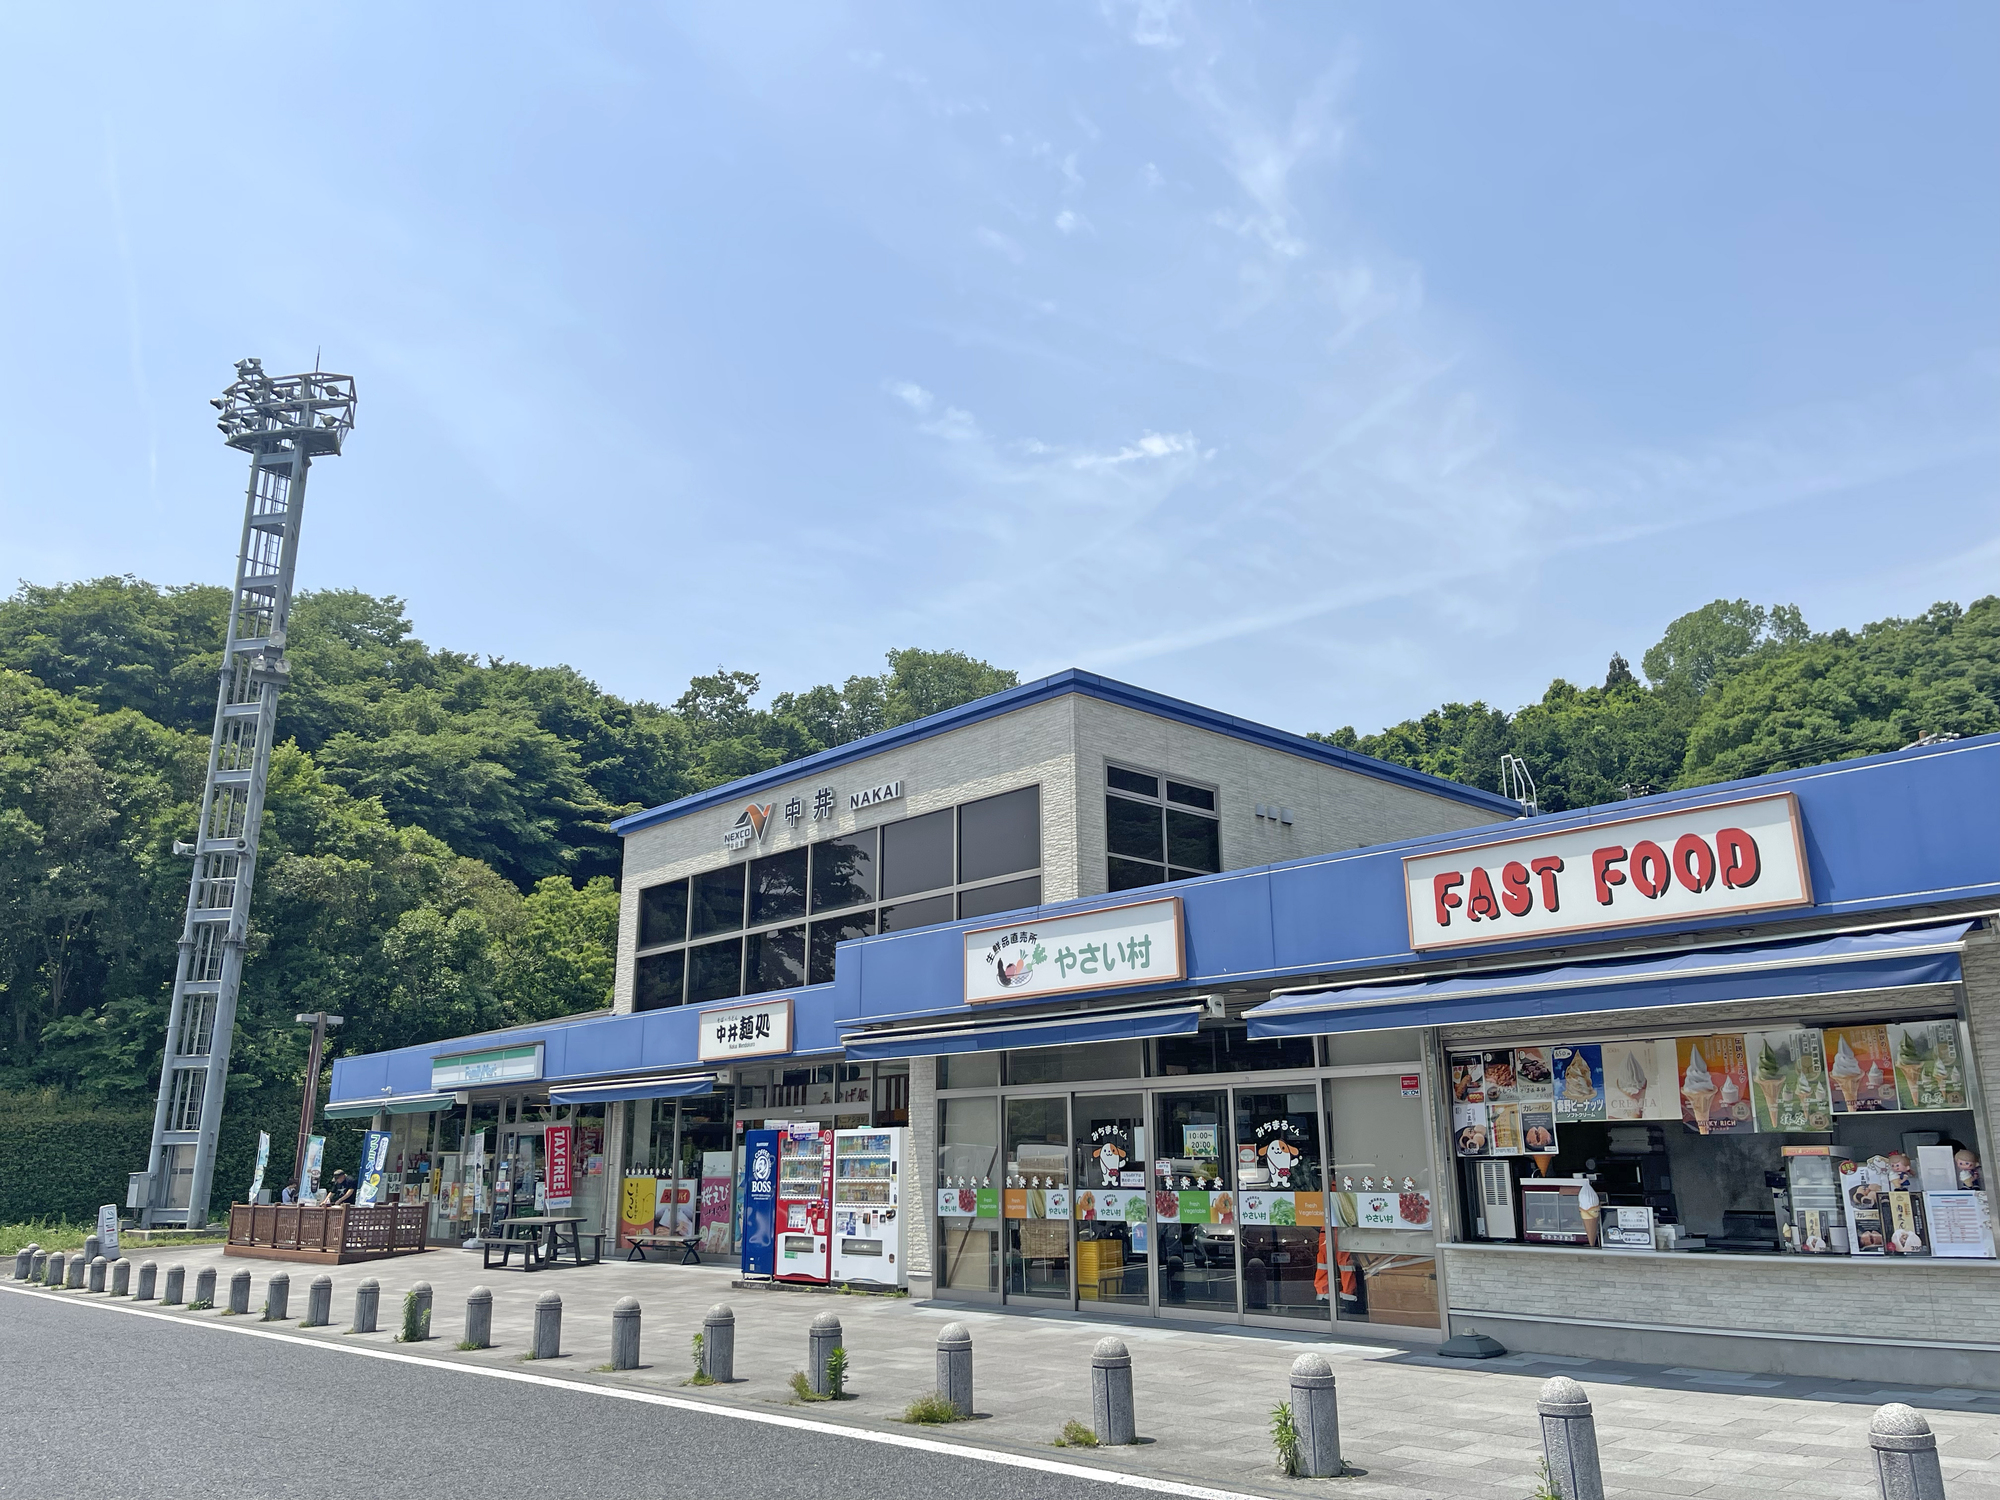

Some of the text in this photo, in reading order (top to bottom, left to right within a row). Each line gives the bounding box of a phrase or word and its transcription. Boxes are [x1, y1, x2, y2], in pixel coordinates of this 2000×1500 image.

[850, 782, 899, 809] NAKAI
[784, 787, 833, 827] 中井
[724, 828, 750, 843] NEXCO
[1434, 826, 1762, 926] FAST FOOD
[985, 931, 1038, 965] 生鮮品直売所
[1054, 933, 1151, 978] やさい村
[1523, 1104, 1549, 1112] カレーパン
[1091, 1125, 1128, 1141] みちまるくん
[1256, 1120, 1300, 1137] みちまるくん
[554, 1130, 565, 1157] TAX
[754, 1148, 770, 1159] COFFEE
[553, 1157, 565, 1190] FREE
[751, 1180, 771, 1193] BOSS
[701, 1183, 730, 1207] 桜えび
[1049, 1207, 1068, 1215] やさい村
[1100, 1208, 1121, 1216] やさい村
[1242, 1211, 1266, 1220] やさい村
[1365, 1214, 1393, 1224] やさい村
